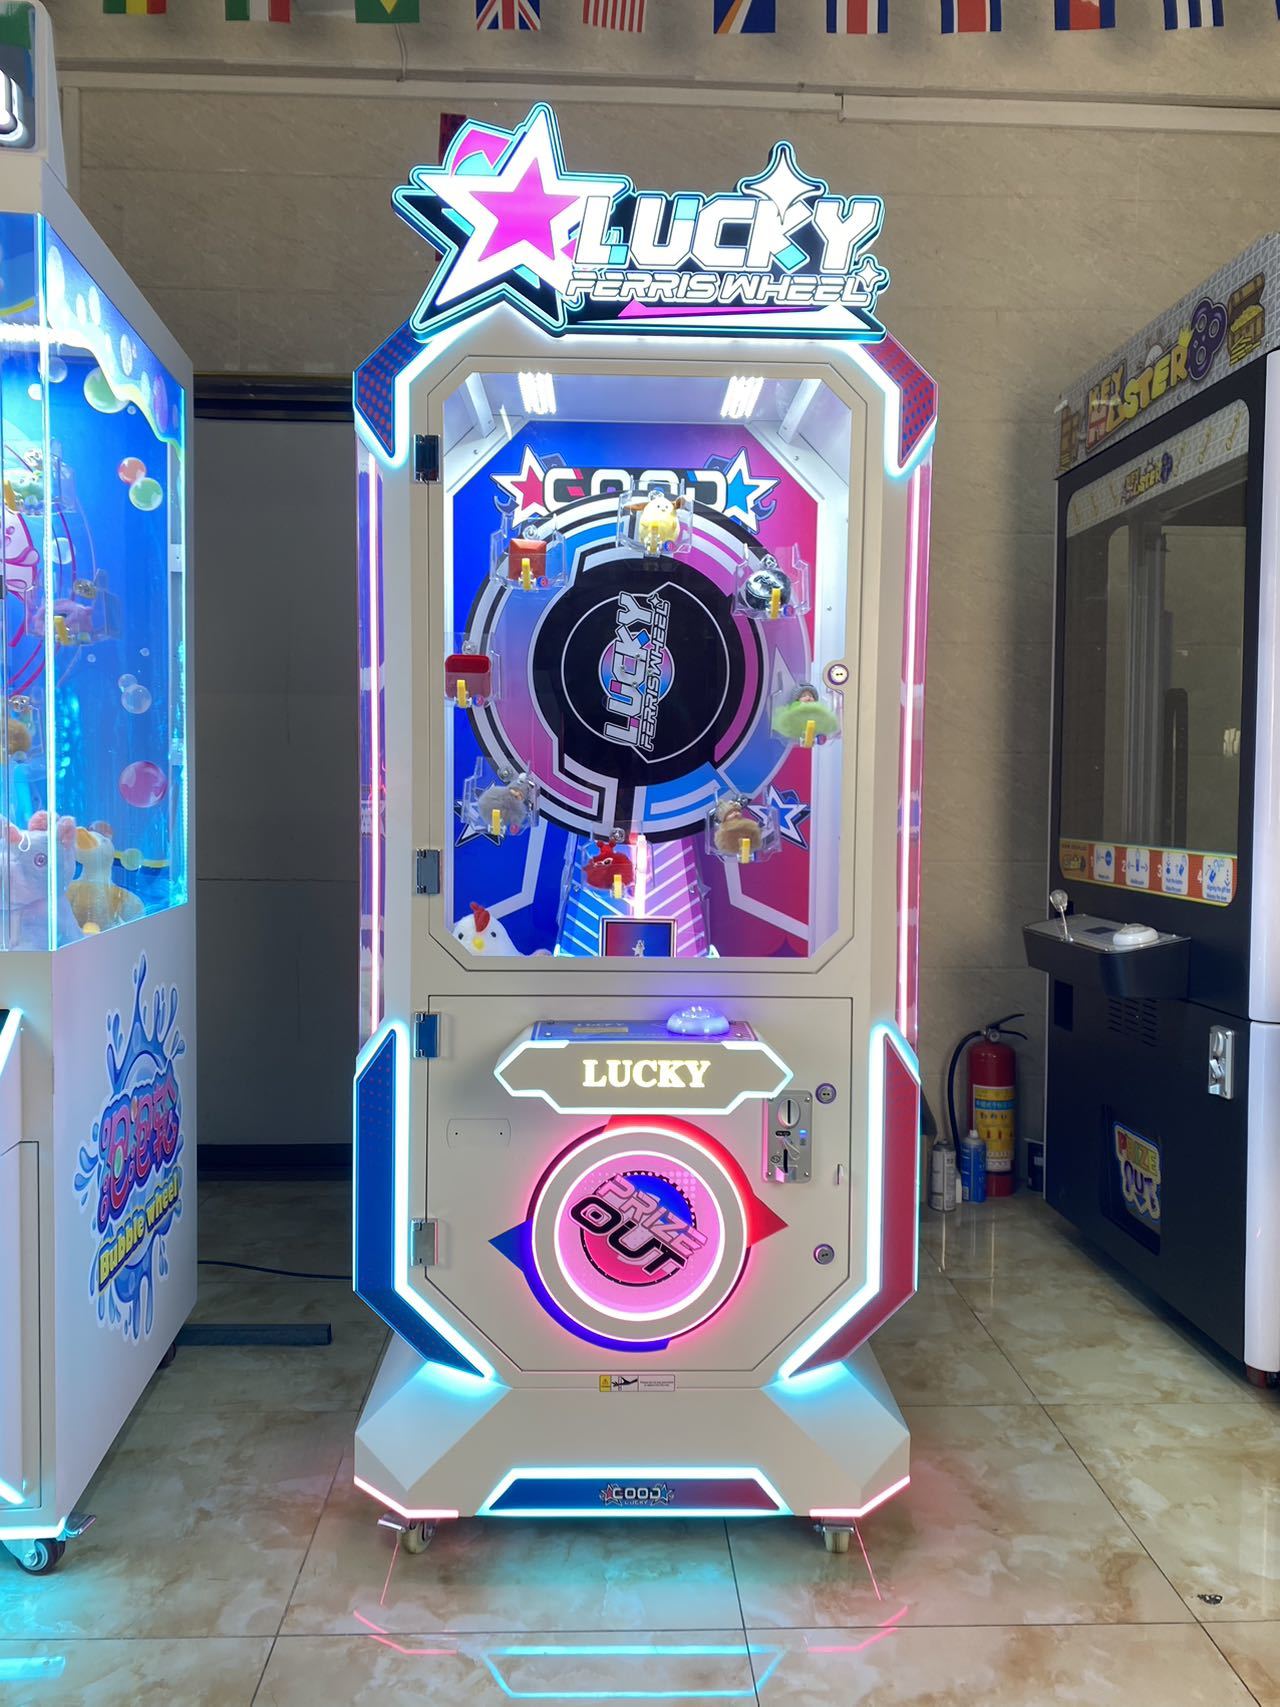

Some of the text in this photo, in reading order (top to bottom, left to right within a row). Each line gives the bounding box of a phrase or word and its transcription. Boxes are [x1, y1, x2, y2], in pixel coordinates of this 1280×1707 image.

[574, 195, 877, 271] LUCKY
[567, 271, 872, 305] FERRIS WHEEL
[604, 591, 653, 746] LUCKY
[582, 1059, 711, 1088] LUCKY
[100, 1174, 179, 1286] Bubble wheel
[570, 1195, 686, 1275] OUT
[595, 1174, 708, 1258] PRIZE
